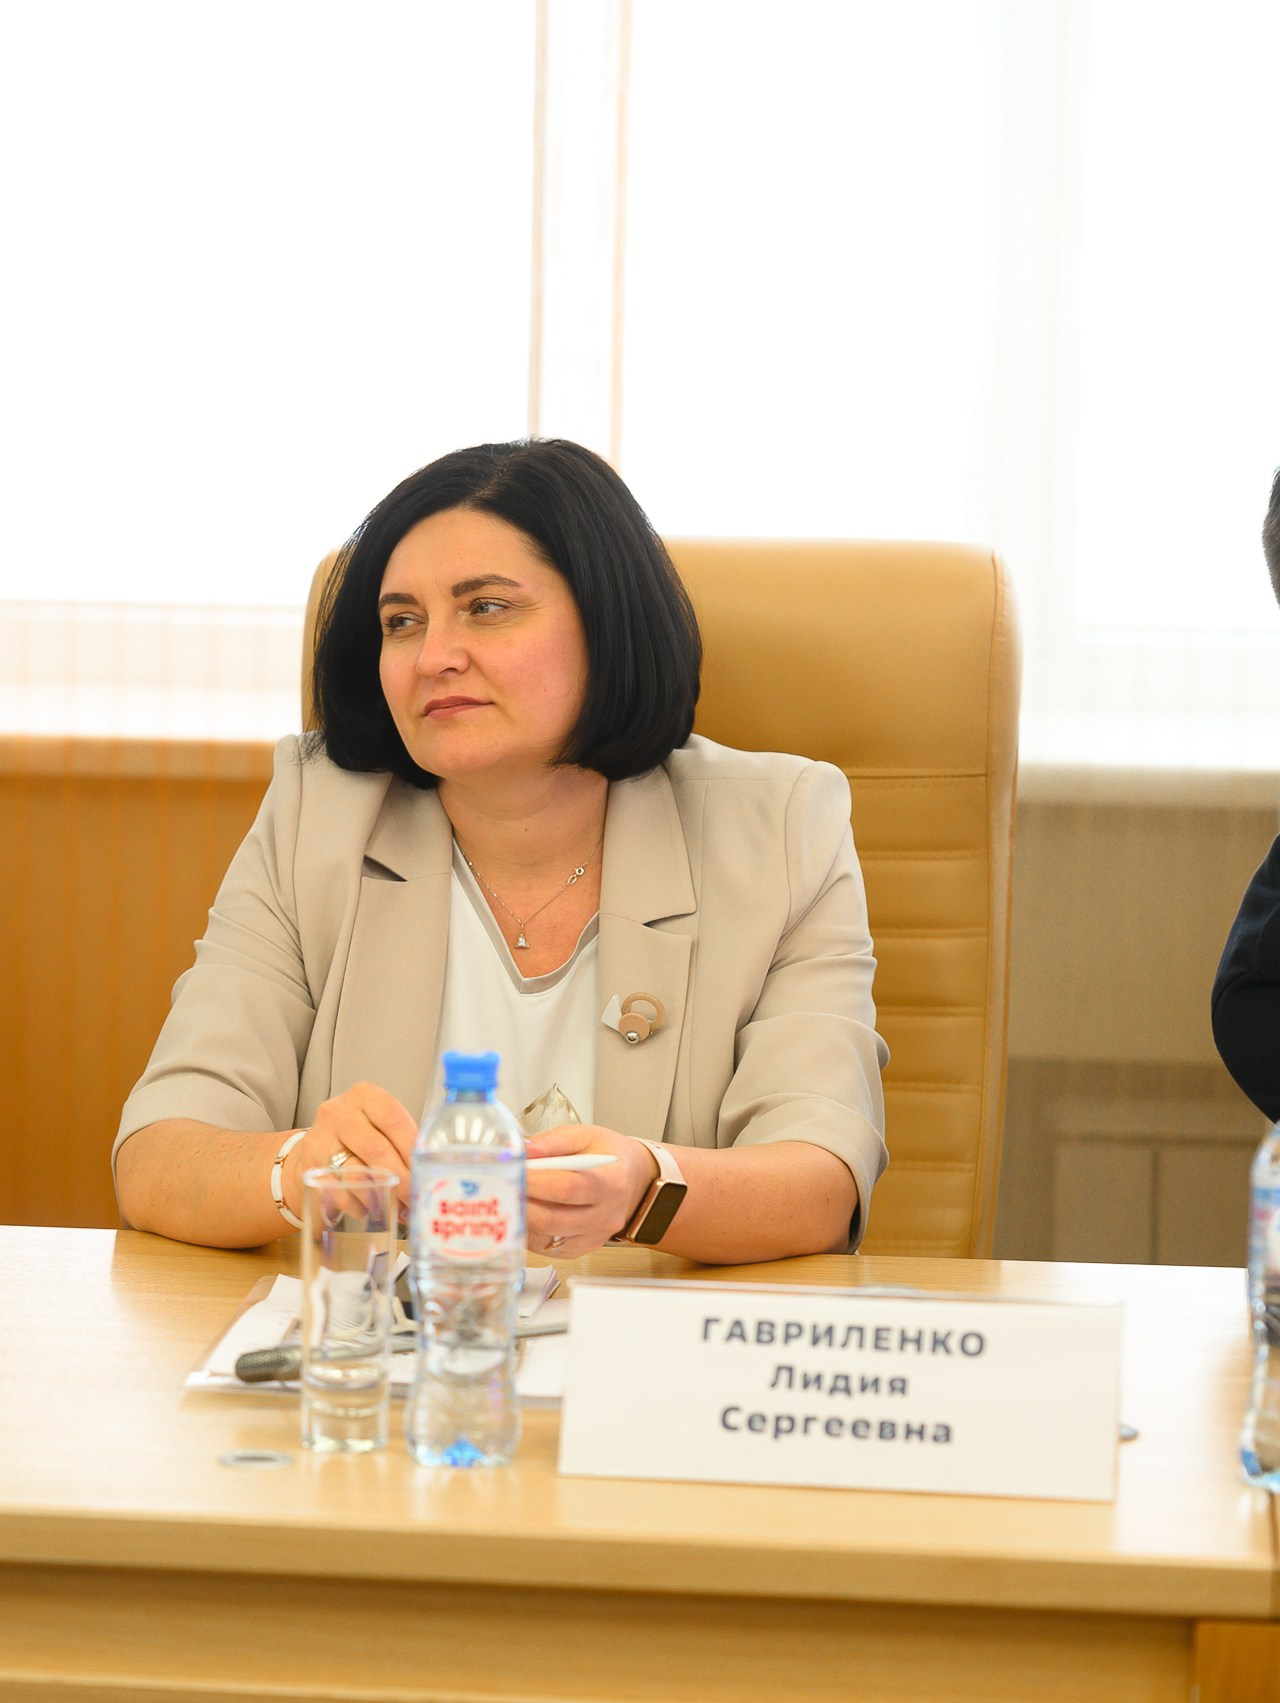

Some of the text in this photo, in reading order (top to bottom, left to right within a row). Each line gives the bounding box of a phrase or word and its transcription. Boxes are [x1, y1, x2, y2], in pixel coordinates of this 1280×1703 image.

[439, 1197, 498, 1217] saint
[431, 1219, 508, 1242] spring
[702, 1317, 985, 1357] ГАВРИЛЕНКО
[770, 1365, 908, 1396] Лидия
[720, 1406, 952, 1443] Сергеевна
